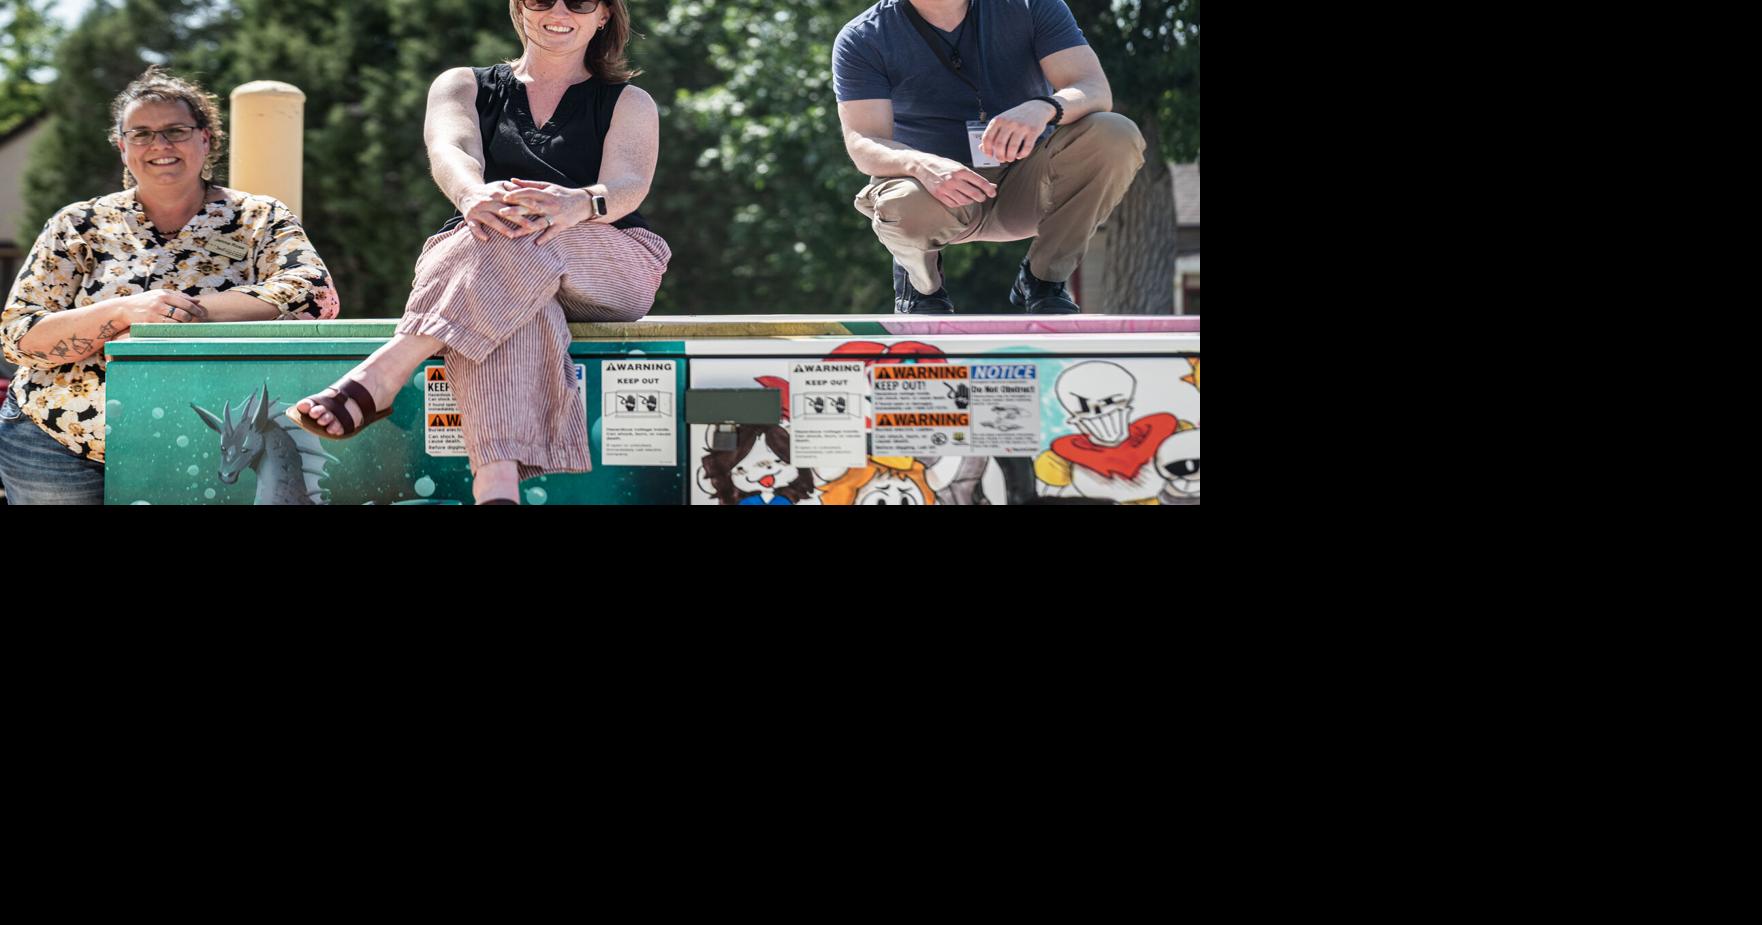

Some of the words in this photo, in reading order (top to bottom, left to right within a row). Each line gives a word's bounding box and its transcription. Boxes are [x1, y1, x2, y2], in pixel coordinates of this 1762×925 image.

[893, 366, 968, 379] WARNING
[974, 366, 1034, 379] NOTICE
[875, 381, 899, 390] KEEP
[902, 381, 926, 390] OUT!
[894, 413, 969, 426] WARNING
